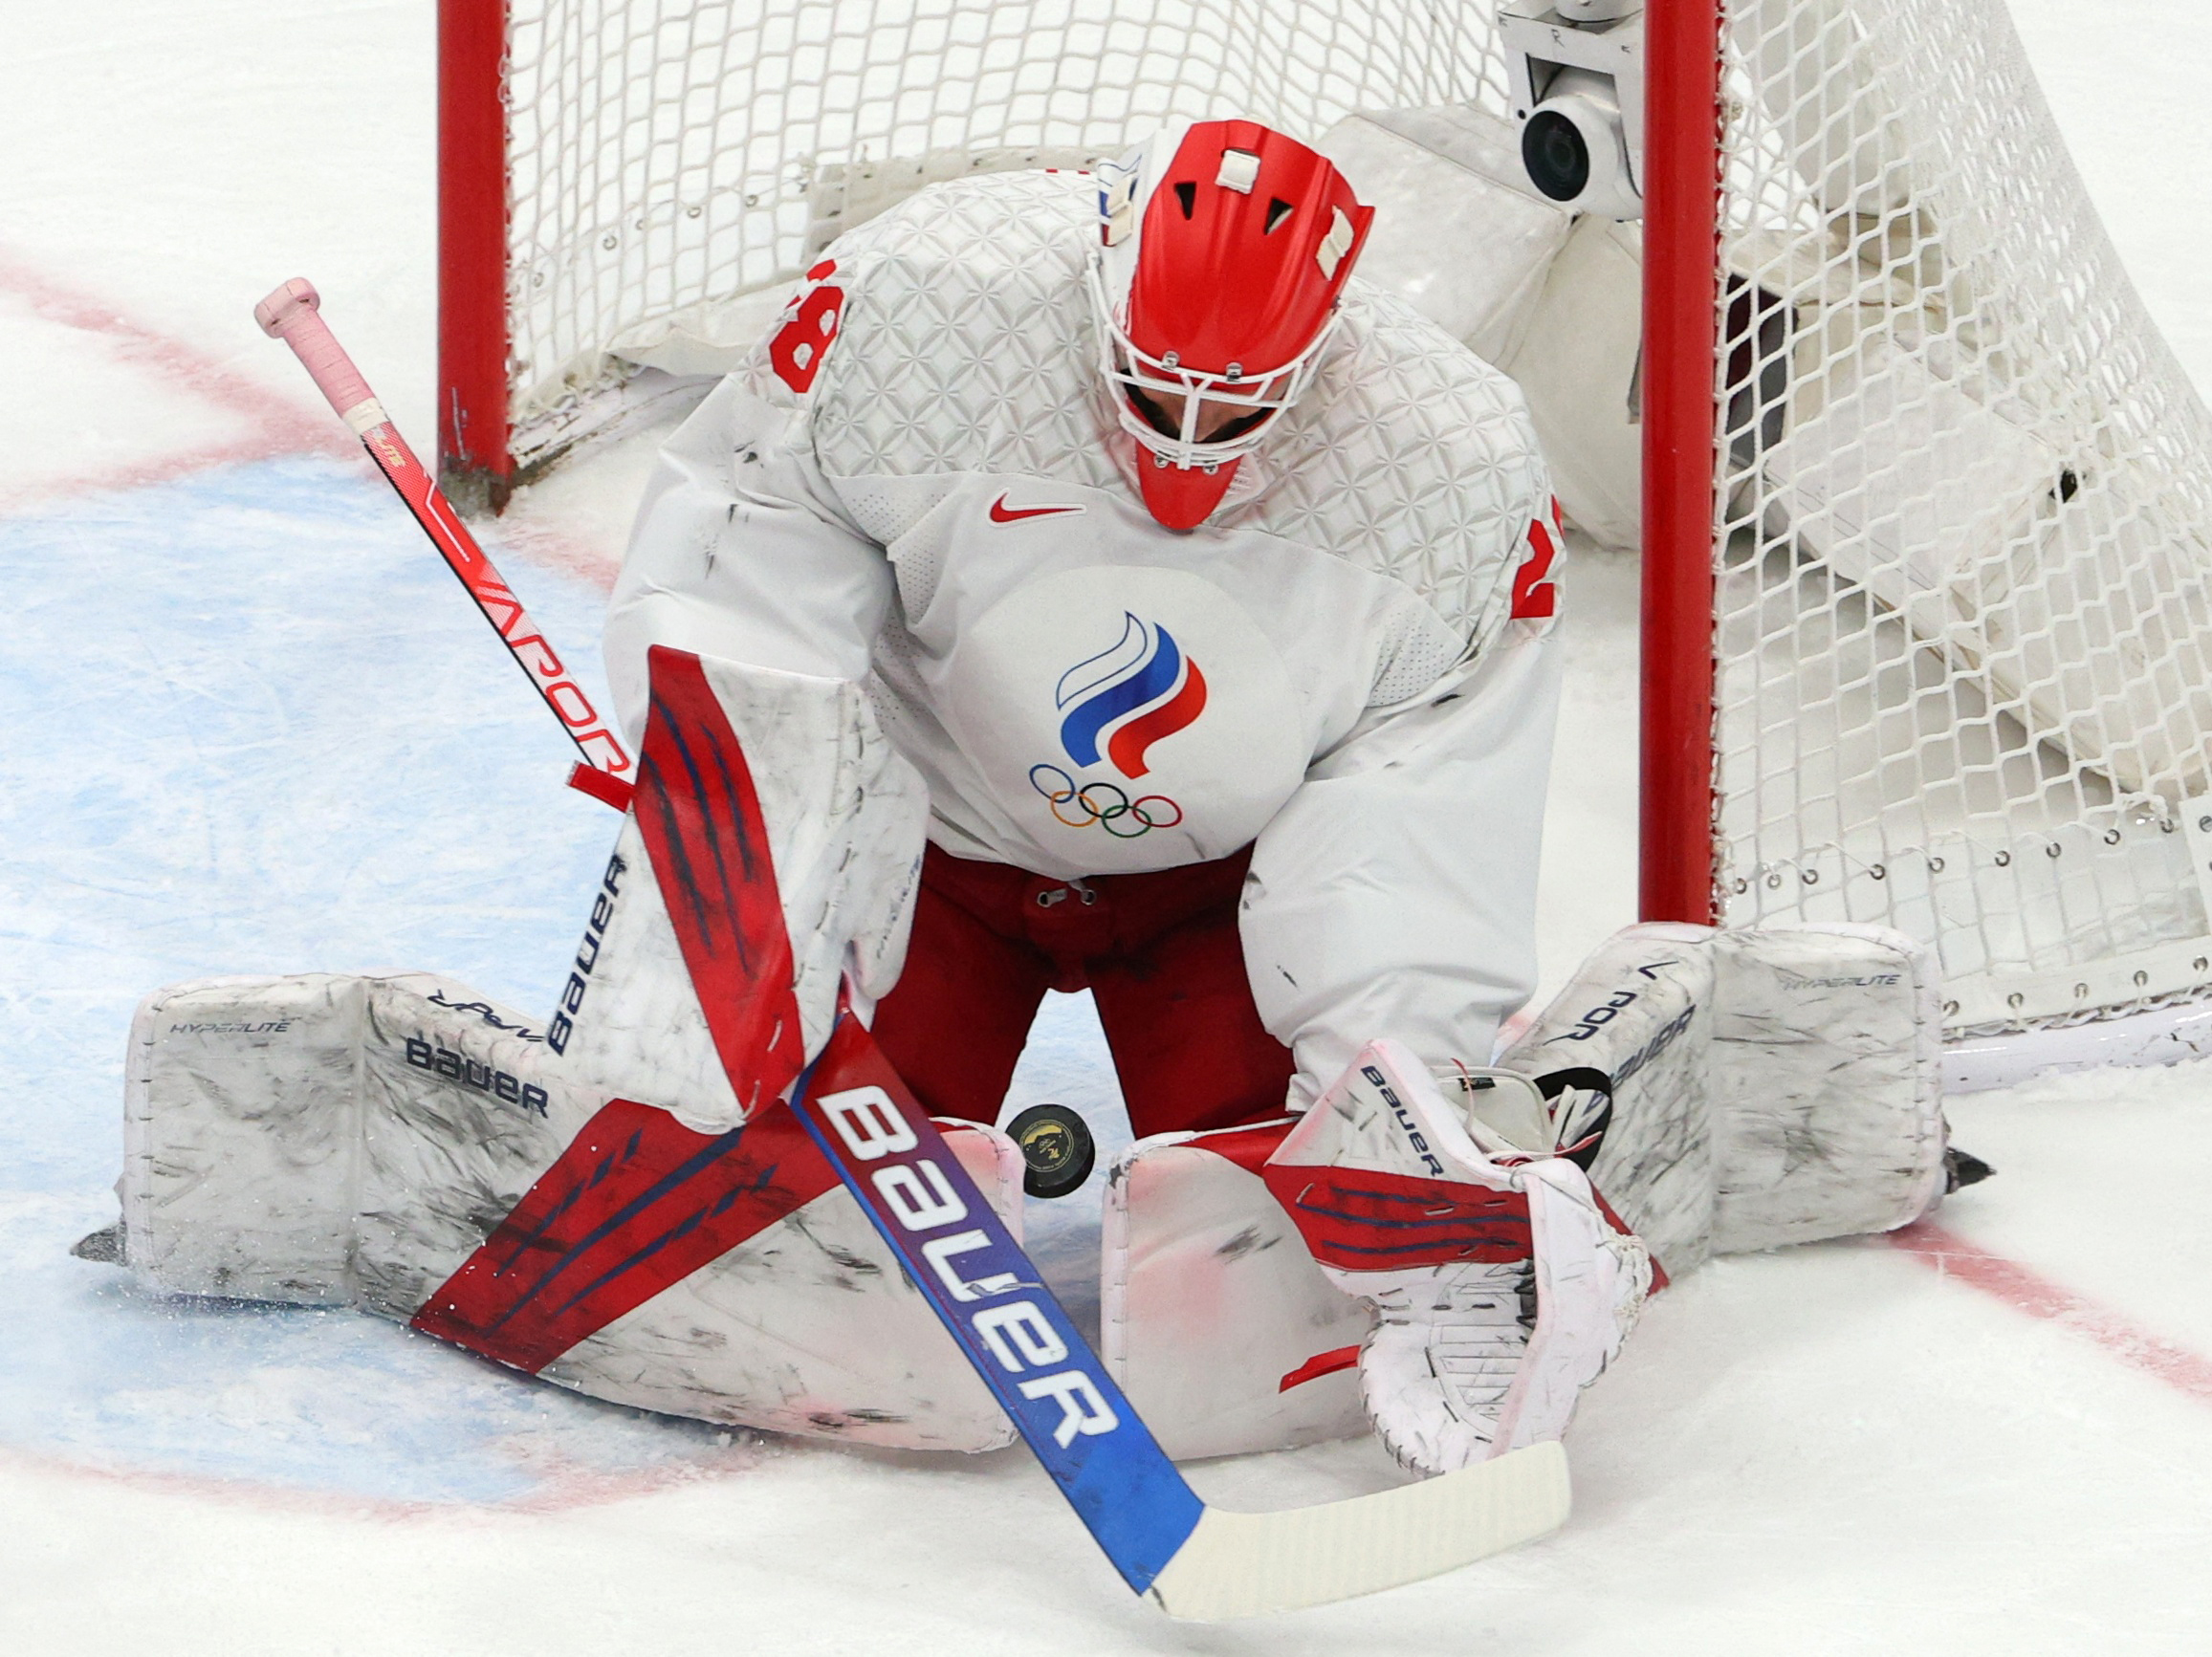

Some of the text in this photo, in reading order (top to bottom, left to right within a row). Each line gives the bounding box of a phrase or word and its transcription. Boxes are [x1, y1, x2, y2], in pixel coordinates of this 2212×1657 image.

[1510, 493, 1566, 620] 2
[547, 854, 627, 1057] BAUER
[1783, 974, 1902, 991] HYPERLITE
[169, 1021, 292, 1034] HYPERLITE
[405, 1036, 549, 1119] BAUER
[1360, 1064, 1444, 1177] BAUER
[816, 1085, 1119, 1449] BAUER
